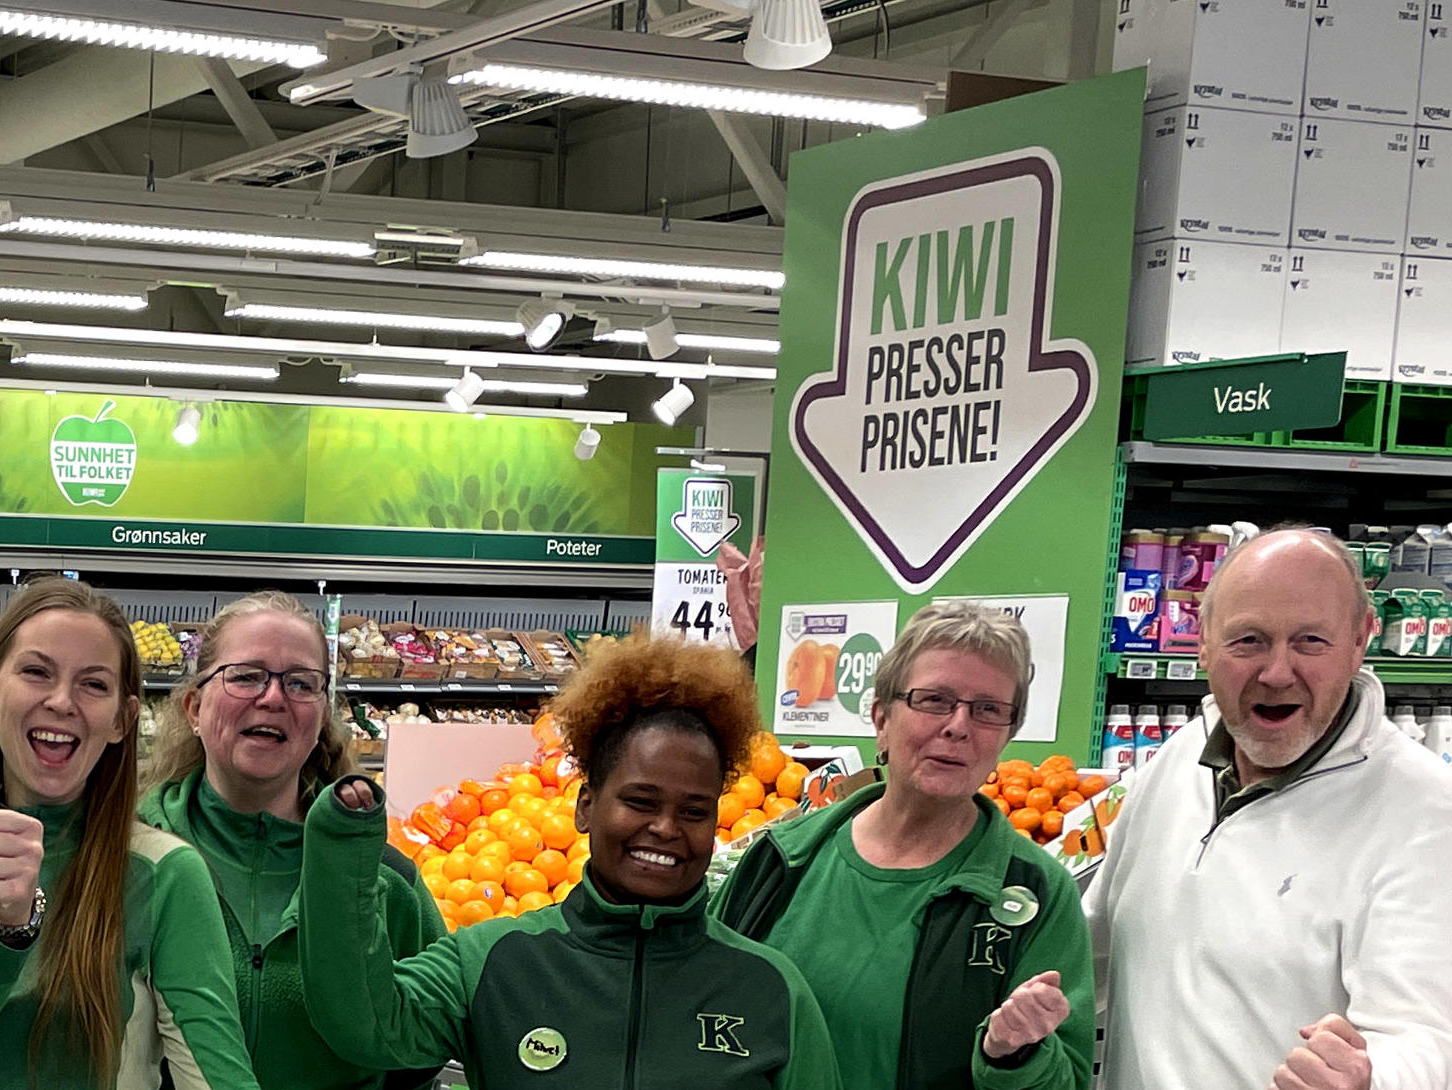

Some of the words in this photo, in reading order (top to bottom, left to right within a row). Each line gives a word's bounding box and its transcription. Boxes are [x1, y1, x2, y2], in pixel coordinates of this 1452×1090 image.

[870, 217, 1015, 335] KIWI
[865, 328, 1007, 405] PRESSER
[1214, 382, 1272, 414] Vask
[860, 400, 1002, 473] PRISENE!
[54, 446, 135, 464] SUNNHET
[57, 465, 77, 478] TIL
[79, 465, 133, 480] FOLKET
[692, 489, 724, 507] KIWI
[691, 508, 724, 521] PRESSER
[112, 526, 207, 546] Grønnsaker
[690, 521, 723, 534] PRISENE!
[546, 539, 602, 556] Poteter
[1129, 597, 1155, 614] OMO
[670, 600, 714, 641] 44
[1405, 621, 1426, 636] OMO
[837, 652, 865, 694] 29
[968, 922, 1012, 975] K
[697, 1013, 750, 1056] K
